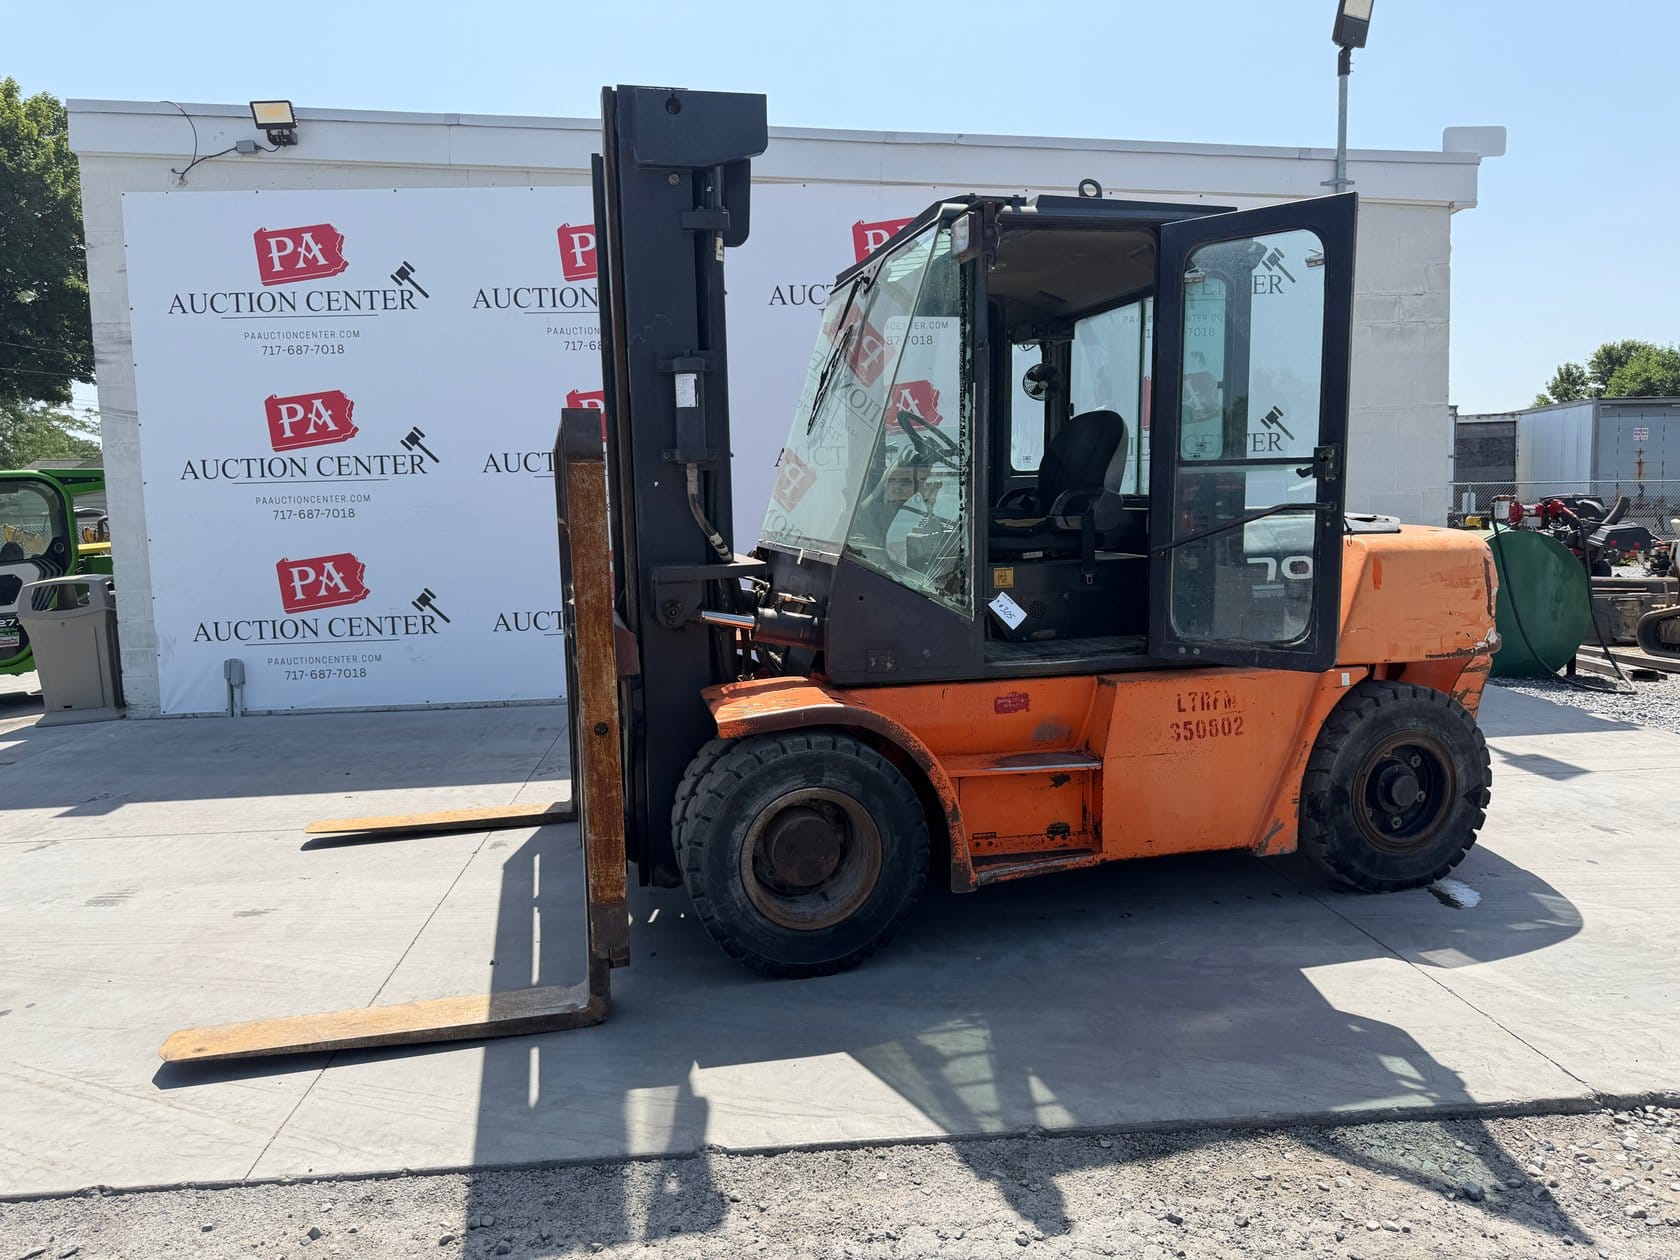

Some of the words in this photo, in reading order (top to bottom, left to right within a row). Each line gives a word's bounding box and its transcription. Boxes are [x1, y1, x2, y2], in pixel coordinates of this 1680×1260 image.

[266, 232, 329, 272] PA
[168, 291, 297, 314] AUCTION
[305, 289, 418, 312] CENTER
[472, 287, 599, 308] AUCTION
[244, 330, 360, 340] PAAUCTIONCENTER.COM
[261, 344, 345, 355] 717-687-7018
[277, 399, 339, 438] PA
[180, 456, 308, 480] AUCTION
[316, 454, 429, 477] CENTER
[255, 494, 371, 505] PAAUCTIONCENTER.COM
[273, 508, 356, 520] 717-687-7018
[1247, 555, 1313, 580] 70
[288, 561, 350, 600] PA
[193, 618, 320, 642] AUCTION
[328, 615, 439, 638] CENTER
[267, 654, 382, 666] PAAUCTIONCENTER.COM
[285, 668, 367, 681] 717-687-7018
